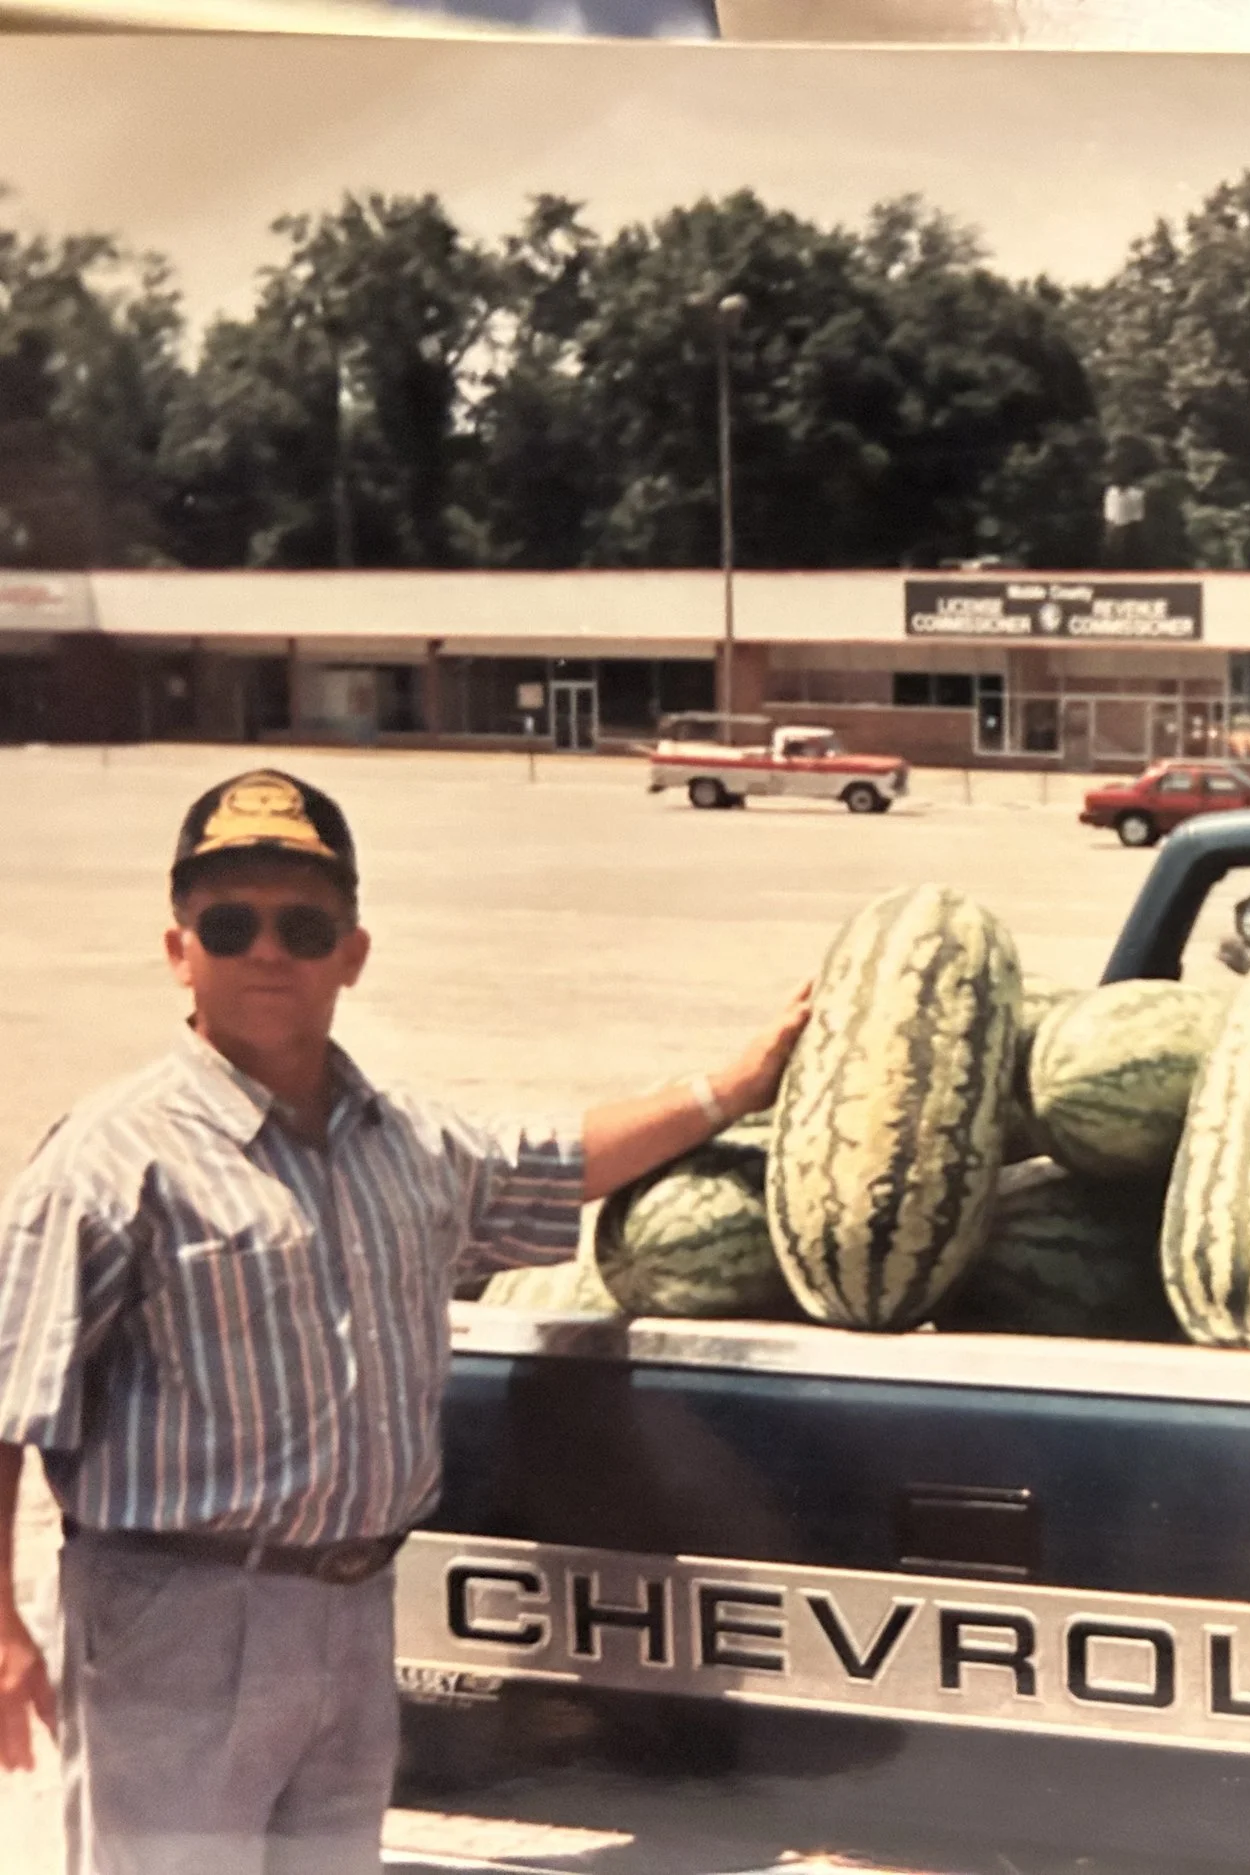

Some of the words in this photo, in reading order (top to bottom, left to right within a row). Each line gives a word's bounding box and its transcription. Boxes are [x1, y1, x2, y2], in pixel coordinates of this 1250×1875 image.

[937, 597, 1004, 615] LICENSE
[1091, 599, 1168, 617] REVENUE
[911, 613, 1033, 633] COMMISSIONER
[1068, 616, 1195, 636] COMMISSIONER
